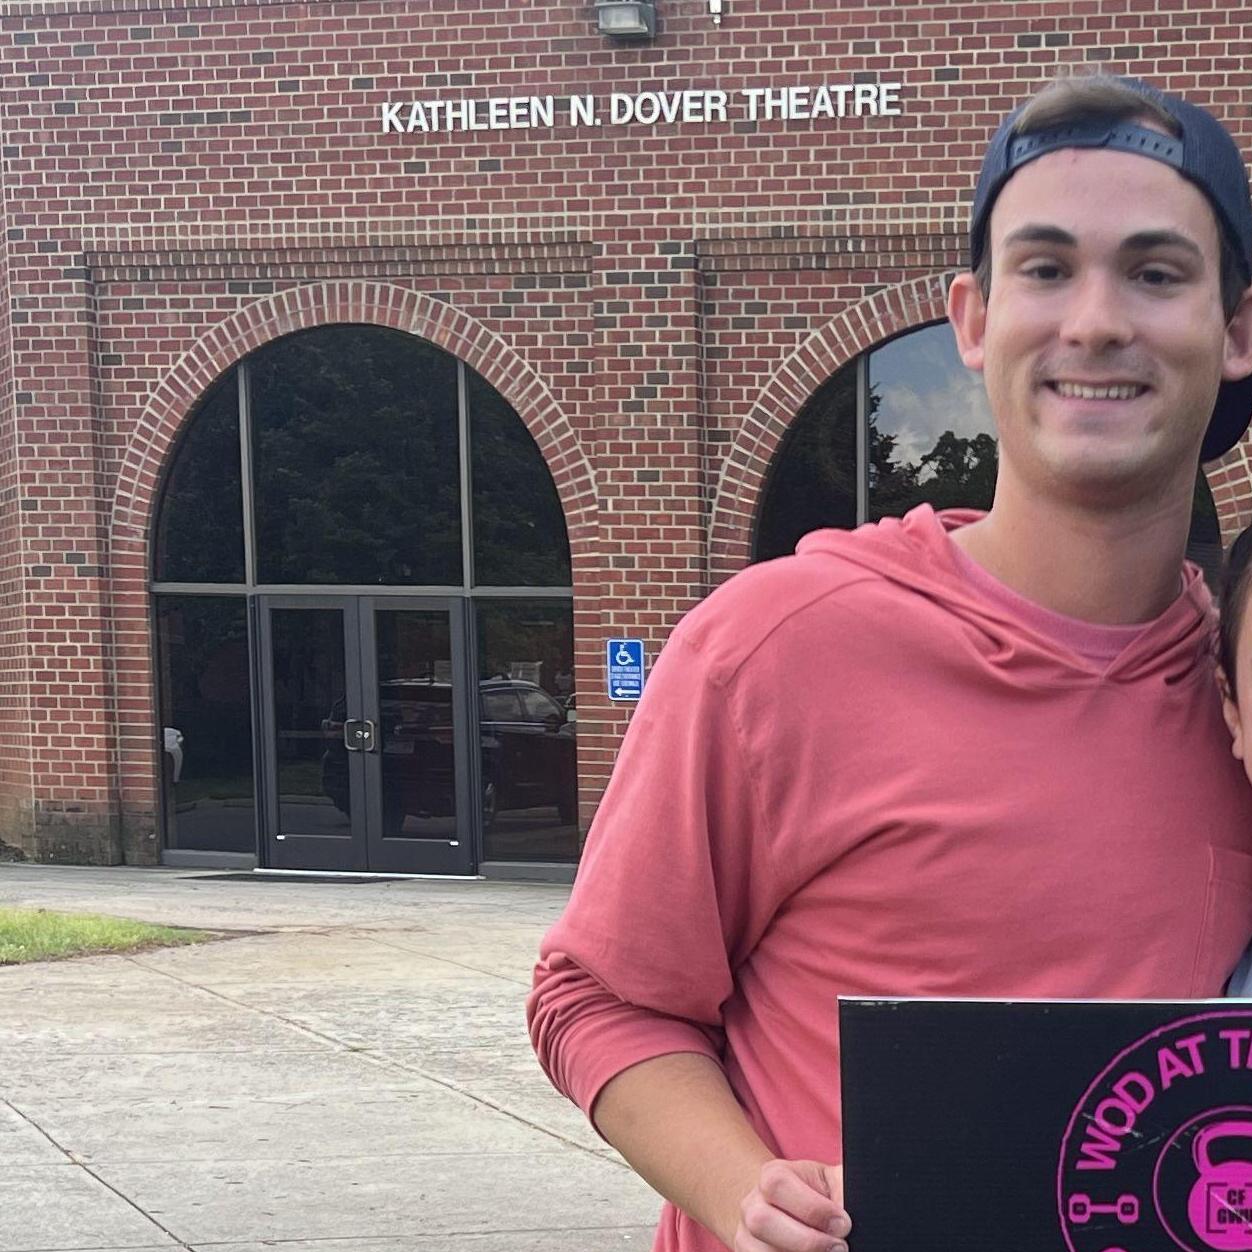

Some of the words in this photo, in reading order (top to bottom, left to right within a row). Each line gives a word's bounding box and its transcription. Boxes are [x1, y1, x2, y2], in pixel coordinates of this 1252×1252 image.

[381, 95, 554, 133] KATHLEEN
[569, 97, 602, 127] N.
[610, 90, 728, 125] DOVER
[741, 83, 902, 120] THEATRE
[1076, 1071, 1155, 1171] WOD
[1157, 1034, 1206, 1089] AT
[1227, 1189, 1246, 1206] CF
